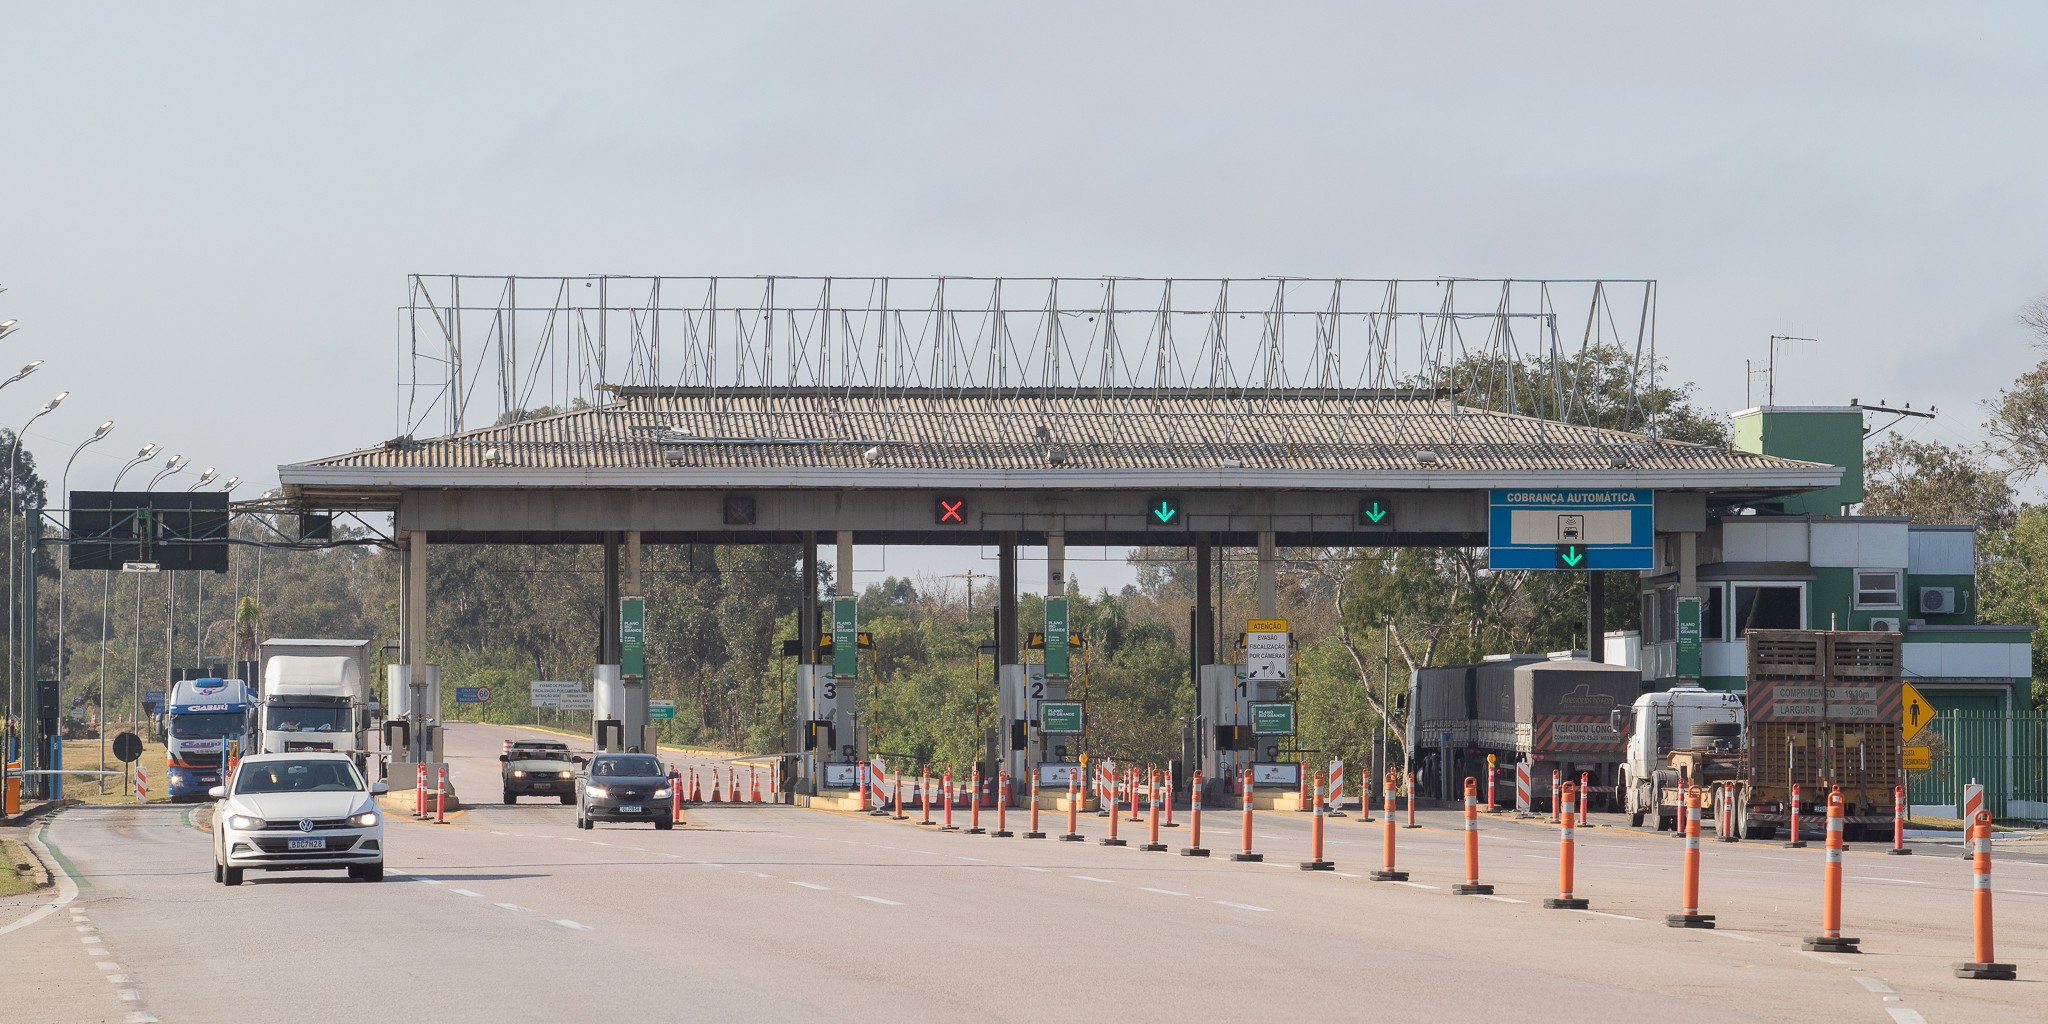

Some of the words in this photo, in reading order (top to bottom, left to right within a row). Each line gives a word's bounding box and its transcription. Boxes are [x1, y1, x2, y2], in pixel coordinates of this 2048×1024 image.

[1507, 493, 1564, 504] COBRANÇA
[1567, 492, 1636, 502] AUTOMÁTICA
[1254, 622, 1281, 630] ATENÇÃO
[824, 683, 836, 699] 3
[1031, 682, 1043, 698] 2
[1238, 682, 1246, 697] 1
[1780, 688, 1835, 698] COMPRIMENTO
[1781, 706, 1815, 714] LARGURA
